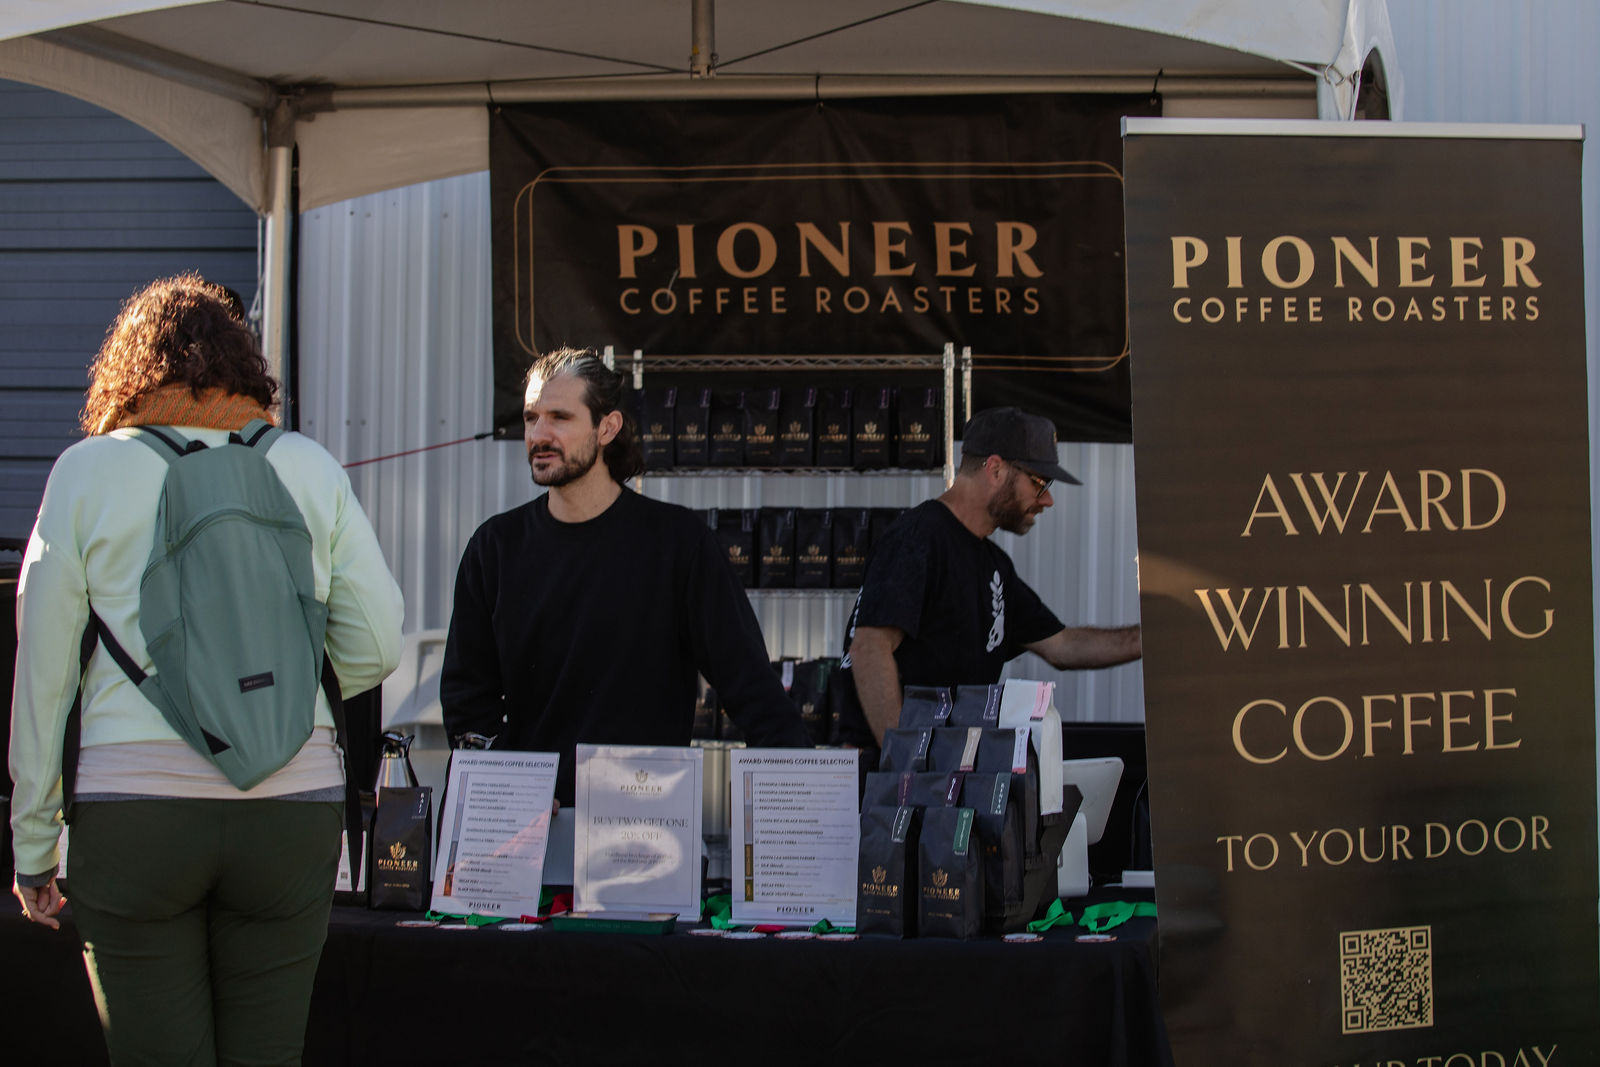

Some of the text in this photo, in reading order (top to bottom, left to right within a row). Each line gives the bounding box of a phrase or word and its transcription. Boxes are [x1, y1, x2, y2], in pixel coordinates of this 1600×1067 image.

[617, 221, 1044, 279] PIONEER
[1171, 235, 1542, 289] PIONEER
[620, 285, 1040, 315] COFFEE ROASTERS
[1173, 295, 1539, 323] COFFEE ROASTERS
[1241, 468, 1506, 537] AWARD
[1193, 576, 1554, 652] WINNING
[1232, 688, 1522, 764] COFFEE
[794, 758, 819, 766] COFFEE
[819, 758, 855, 766] SELECTION
[620, 785, 662, 793] PIONEER
[1217, 815, 1553, 873] TO YOUR DOOR
[378, 858, 418, 868] PIONEER
[862, 882, 898, 893] PIONEER
[468, 901, 501, 911] PIONEER
[776, 906, 815, 914] PIONEER
